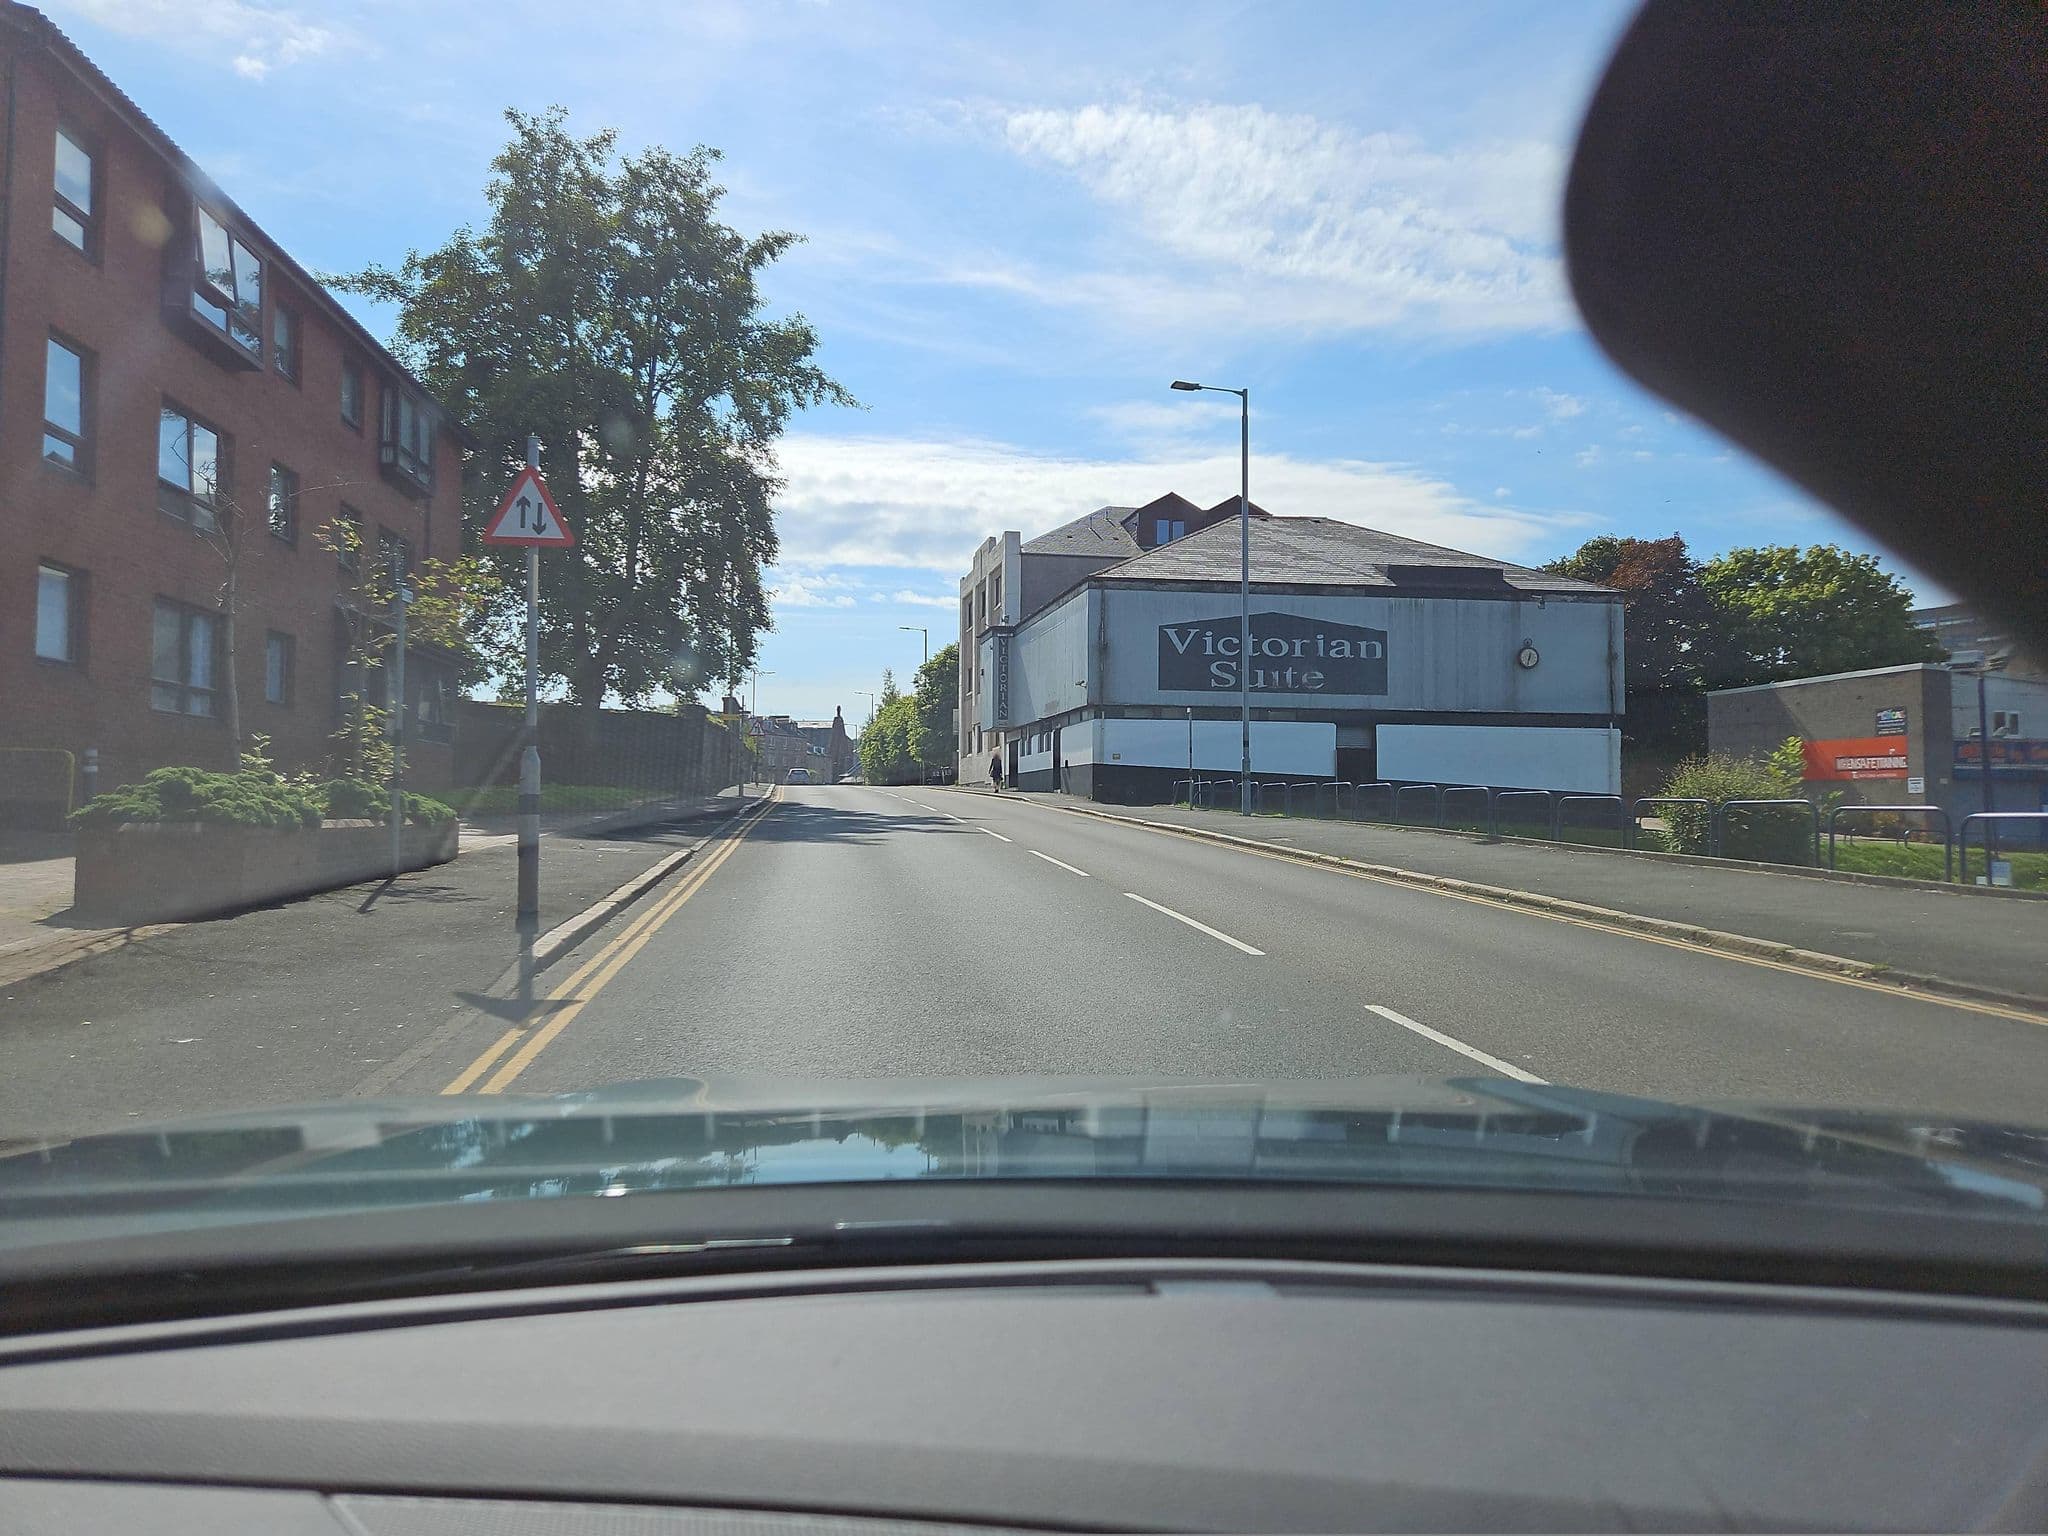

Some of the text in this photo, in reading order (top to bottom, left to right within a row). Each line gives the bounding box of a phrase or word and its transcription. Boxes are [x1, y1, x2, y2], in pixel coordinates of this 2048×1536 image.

[1163, 627, 1383, 660] Victorian
[999, 637, 1009, 718] VICTORIAN
[1209, 660, 1326, 690] Suite
